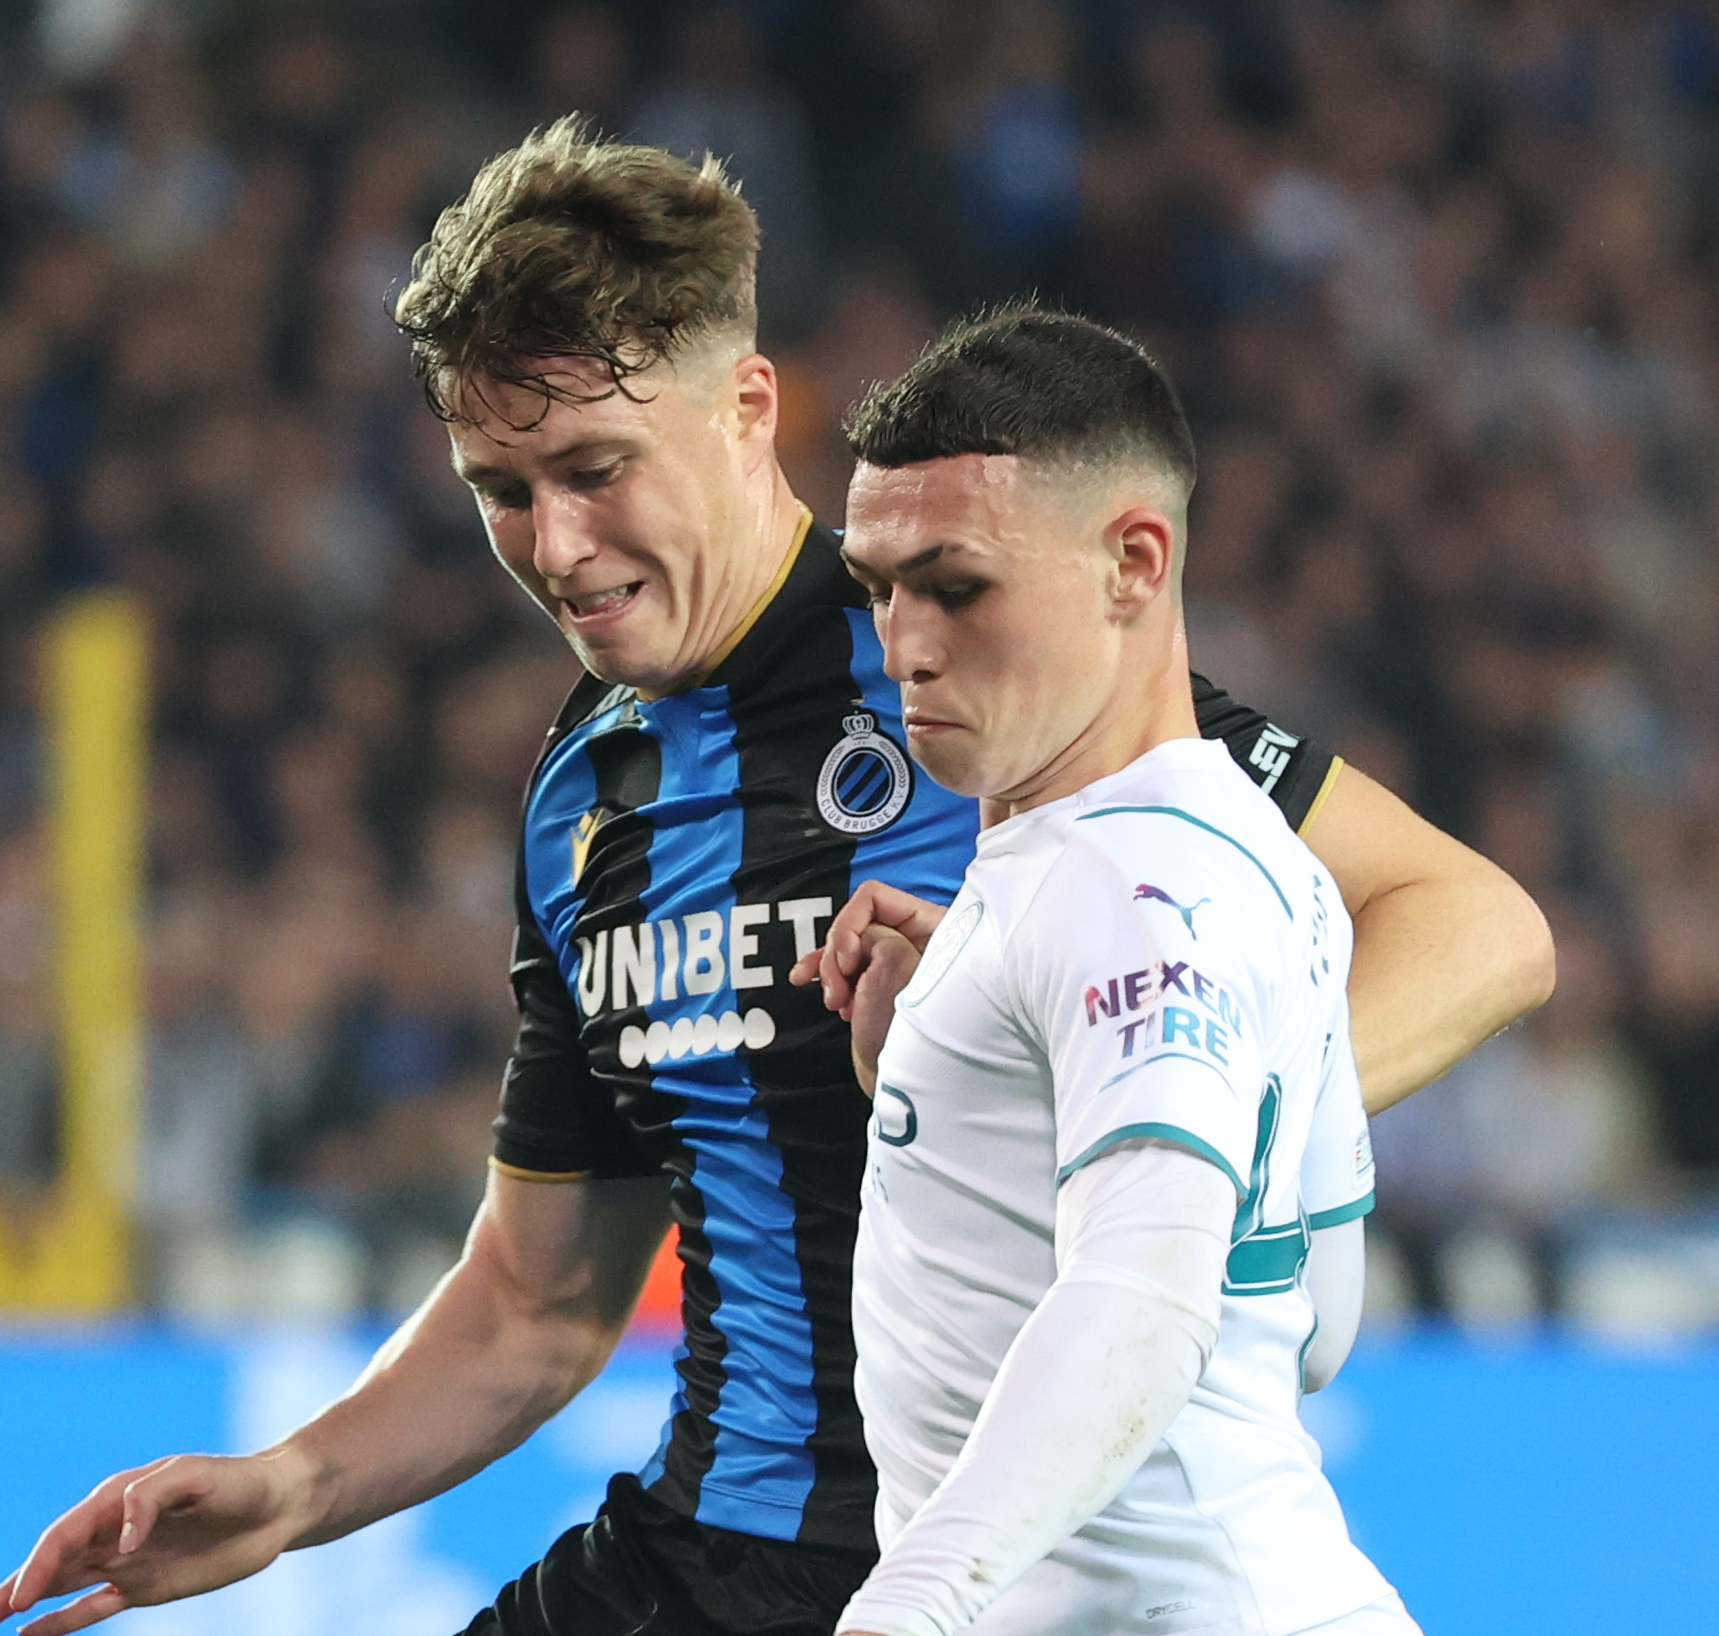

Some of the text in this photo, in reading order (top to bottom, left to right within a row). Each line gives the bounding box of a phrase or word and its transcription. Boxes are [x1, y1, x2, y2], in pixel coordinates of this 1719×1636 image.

[822, 798, 842, 824] CLUB
[843, 809, 892, 830] BRUGGE
[576, 896, 833, 1017] UNIBET
[1085, 960, 1242, 1040] NEXEN
[1116, 1006, 1229, 1067] TIRE
